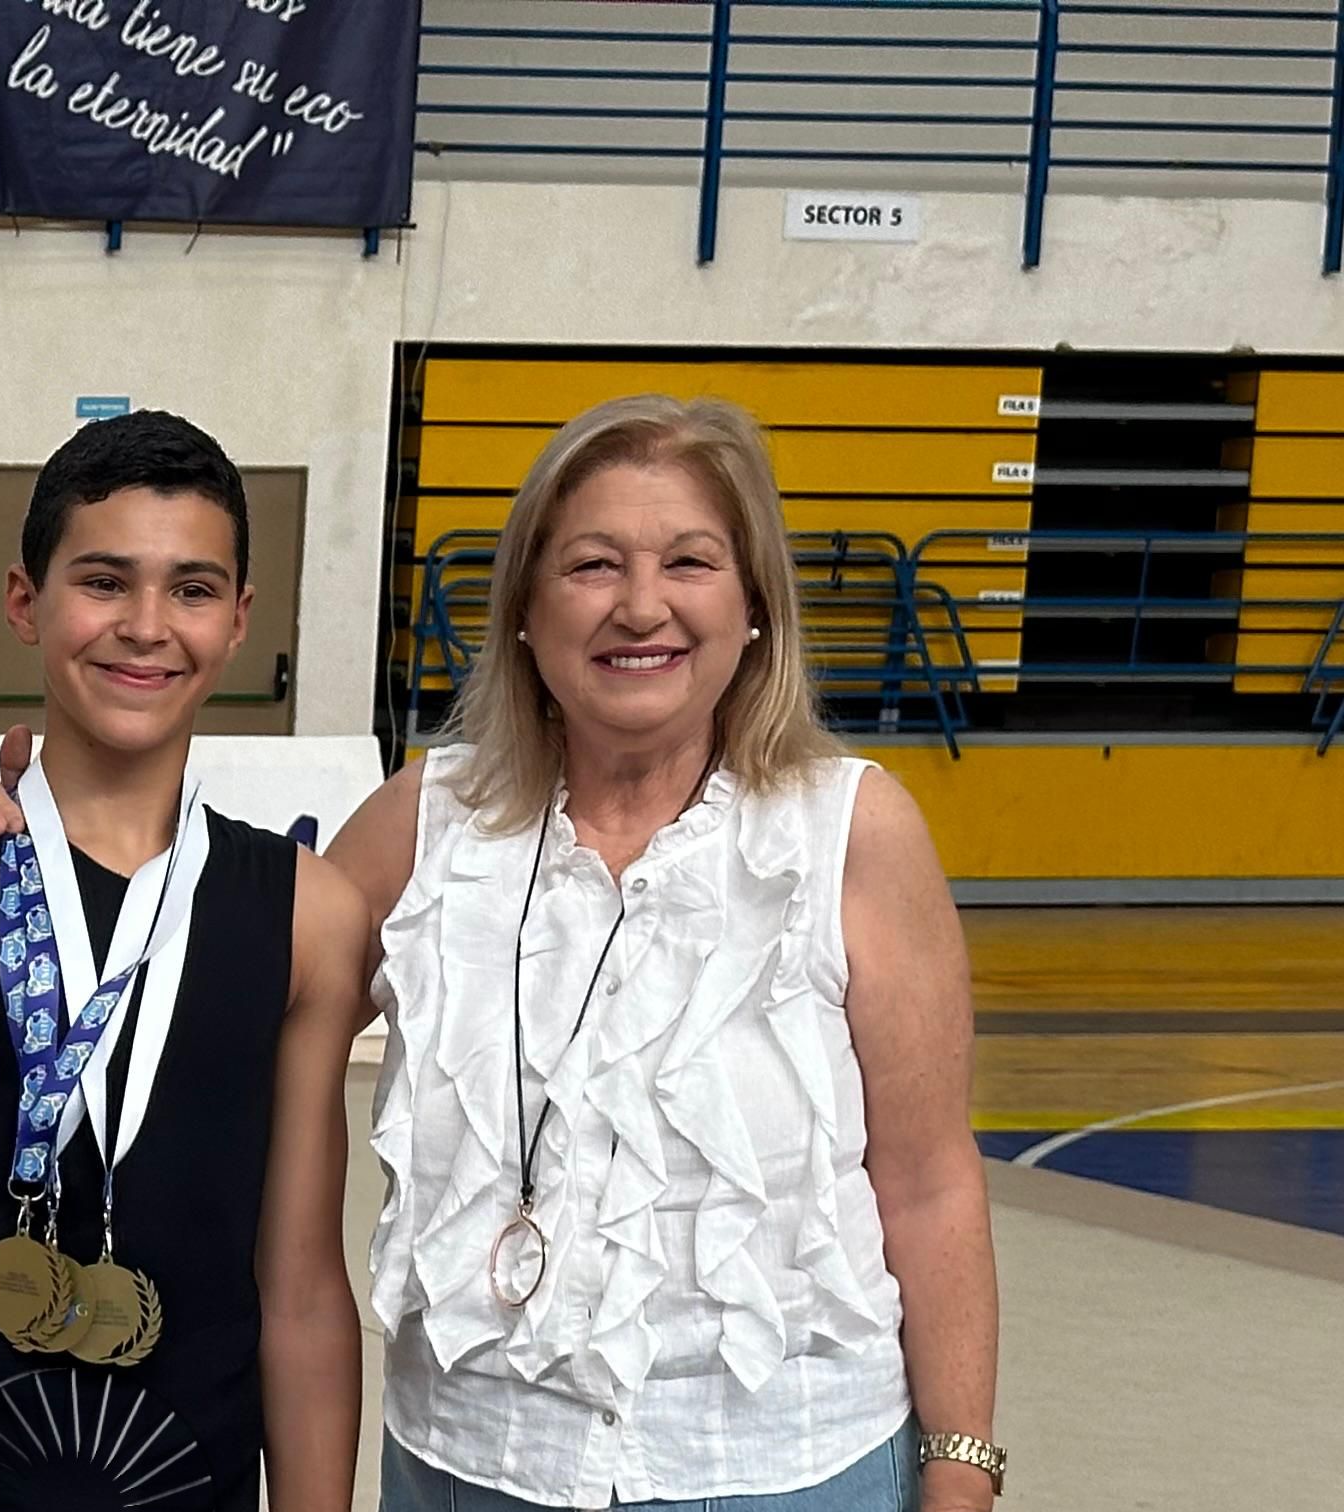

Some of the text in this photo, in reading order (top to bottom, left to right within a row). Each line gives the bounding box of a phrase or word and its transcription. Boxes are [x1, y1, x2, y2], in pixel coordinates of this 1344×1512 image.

[8, 24, 59, 99] la
[231, 60, 279, 103] su
[284, 85, 364, 133] eco
[803, 205, 902, 226] SECTOR 5
